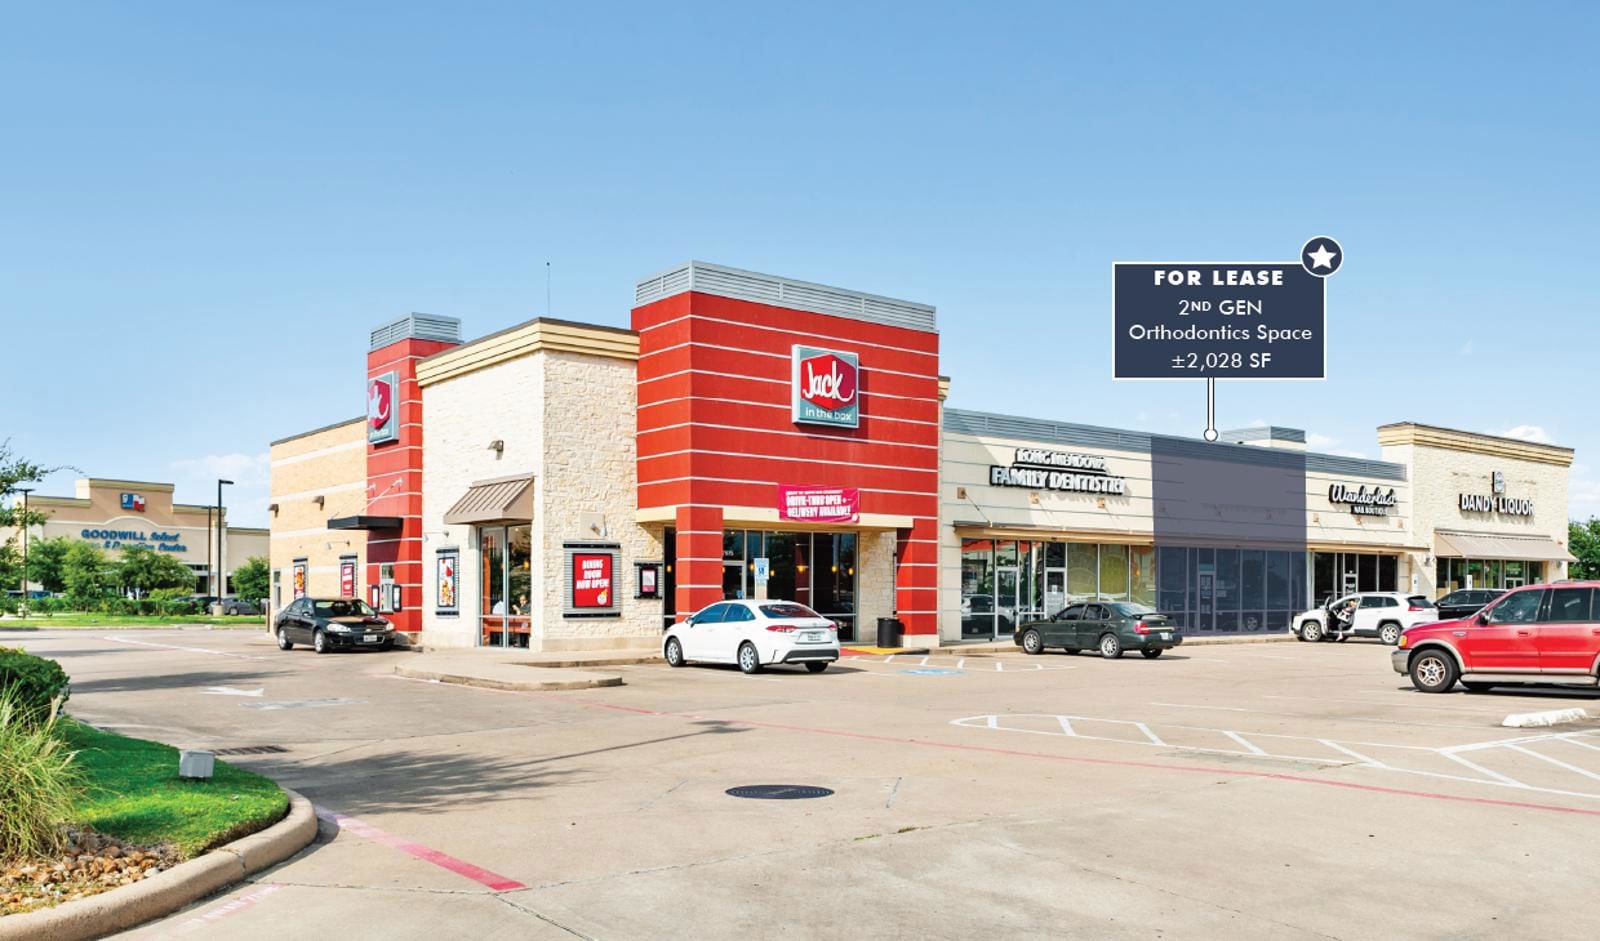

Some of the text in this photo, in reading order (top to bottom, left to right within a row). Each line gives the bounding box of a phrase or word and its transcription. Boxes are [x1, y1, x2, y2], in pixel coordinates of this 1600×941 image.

[802, 360, 855, 402] Jack
[805, 407, 852, 420] in the box
[990, 465, 1048, 488] FAMILY
[1329, 484, 1398, 506] Wanderlust
[1459, 493, 1535, 516] DANDY LIQUOR
[81, 529, 146, 541] GOODWILL
